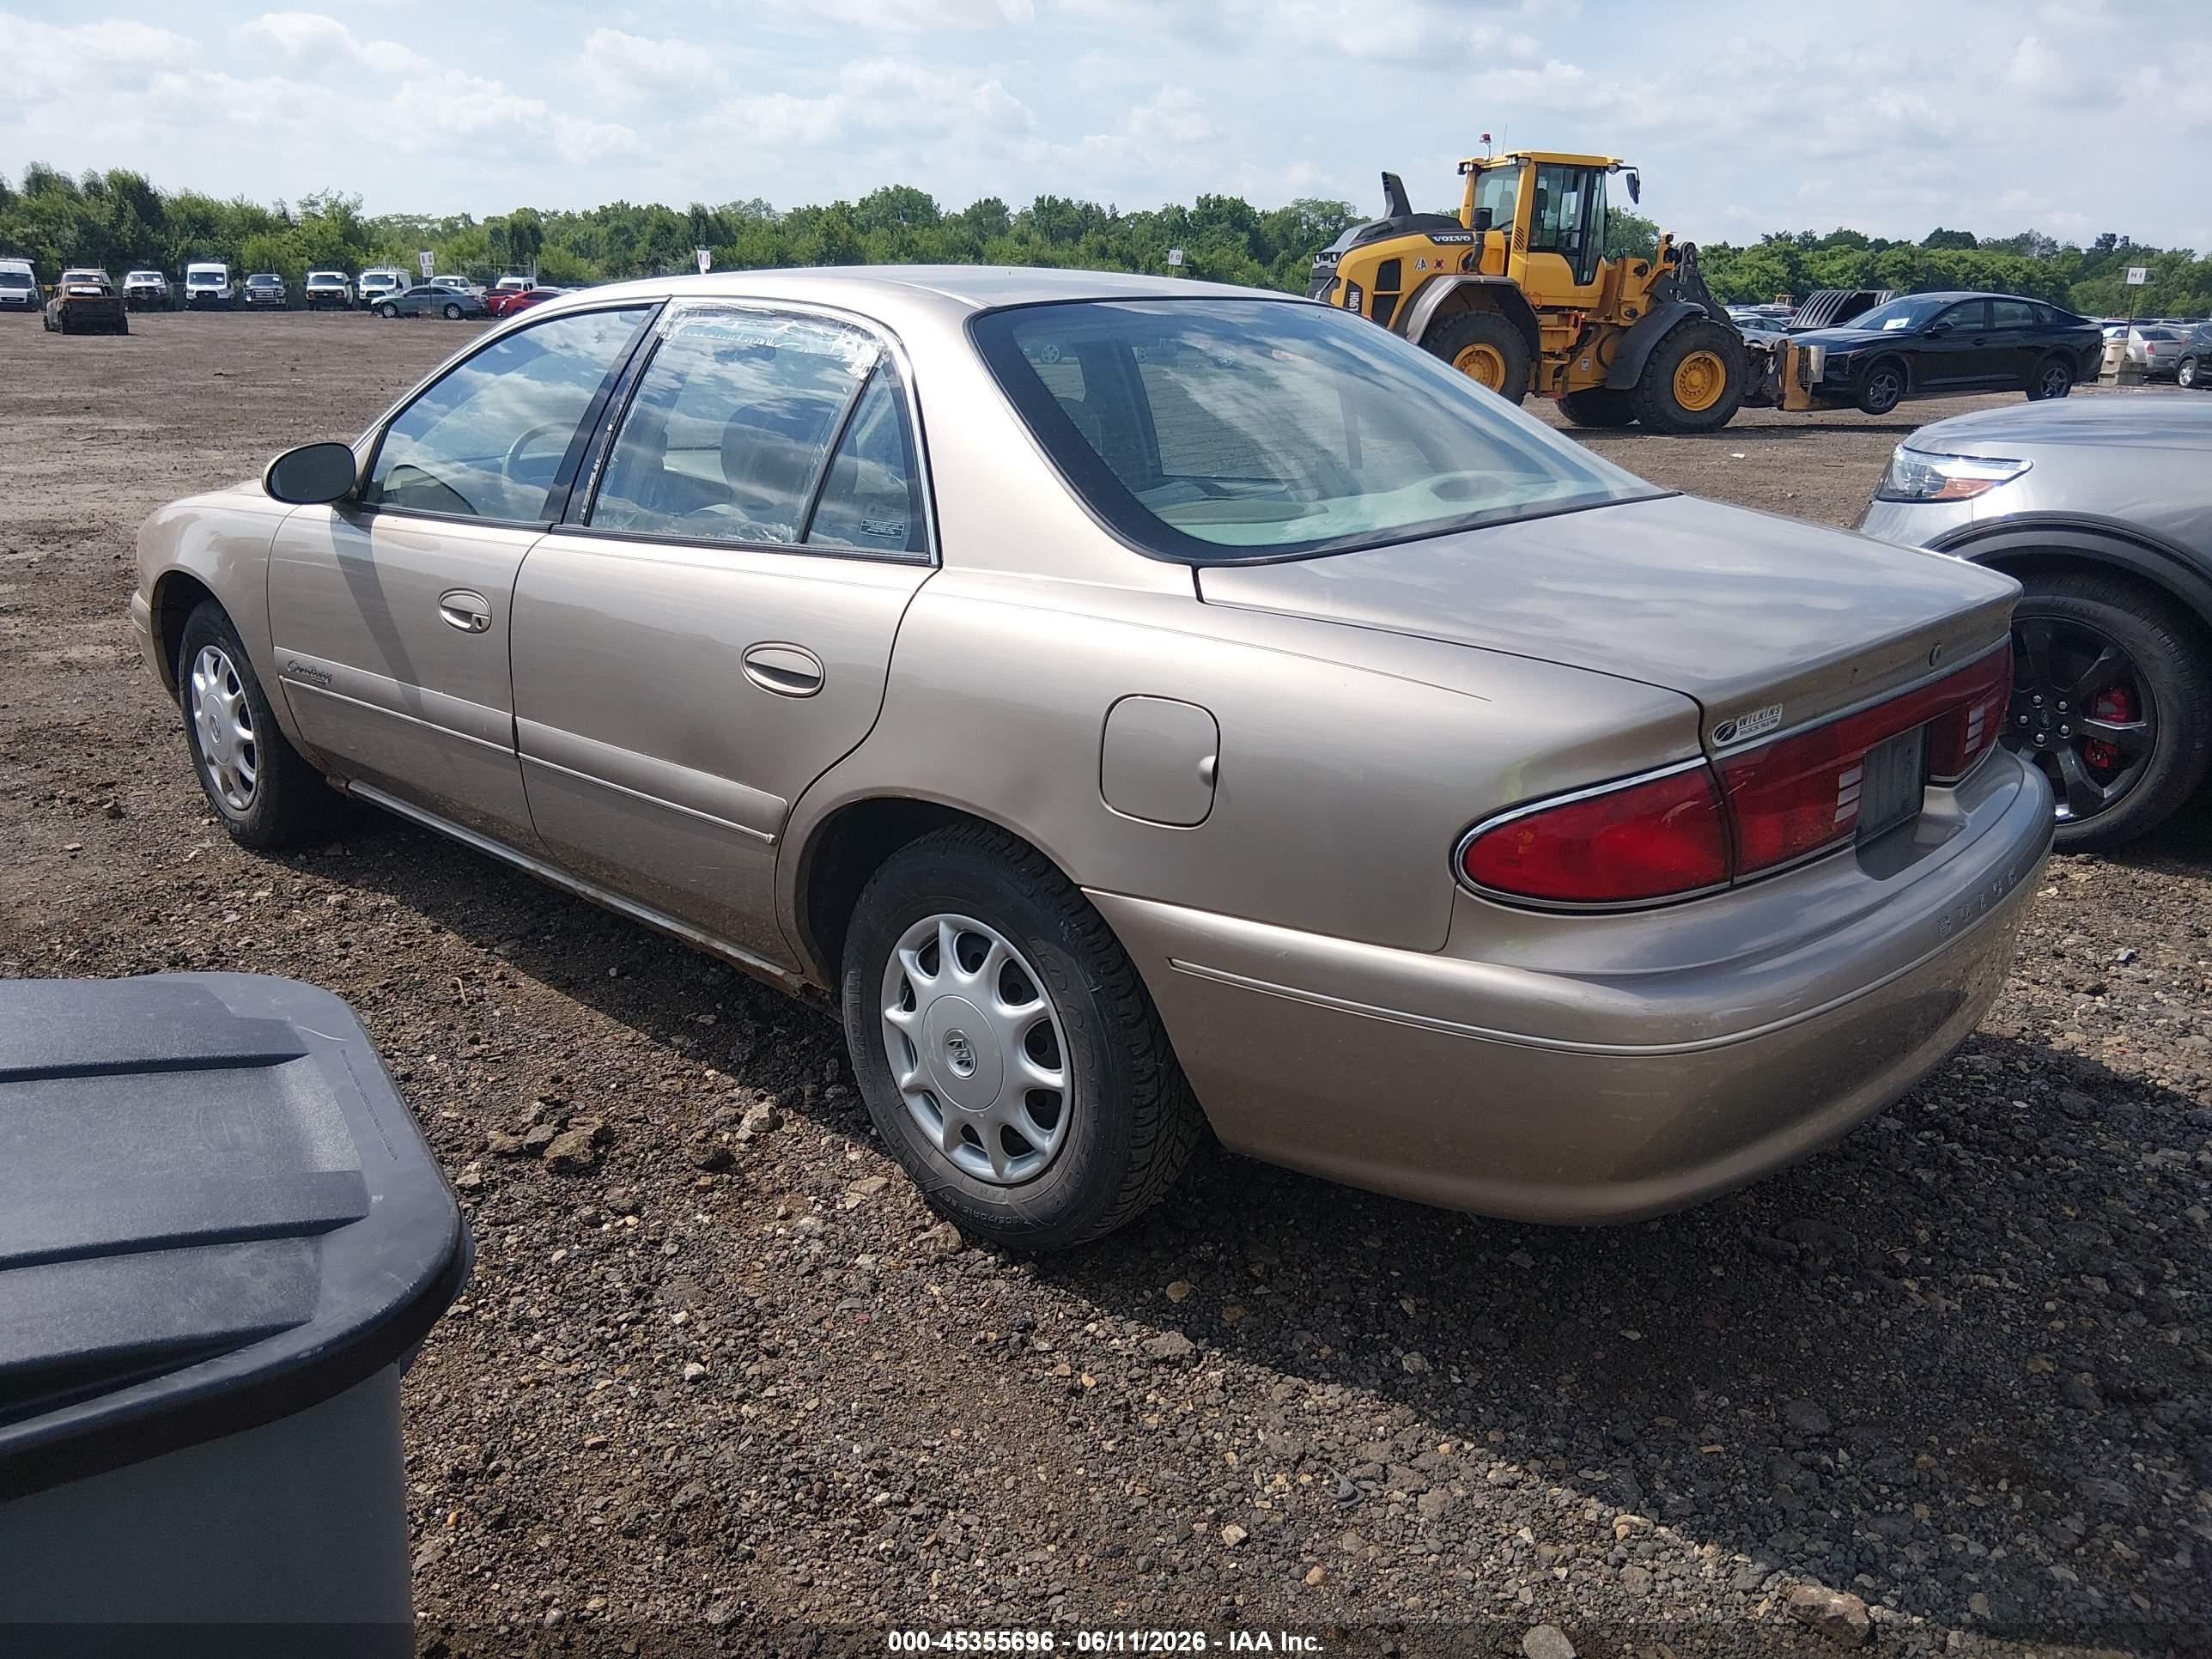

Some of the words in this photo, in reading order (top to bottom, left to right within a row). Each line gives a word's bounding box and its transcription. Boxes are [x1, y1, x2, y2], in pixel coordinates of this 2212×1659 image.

[1349, 291, 1360, 311] L90H
[1738, 706, 1782, 727] WILKINS
[1937, 867, 2017, 936] BUICK
